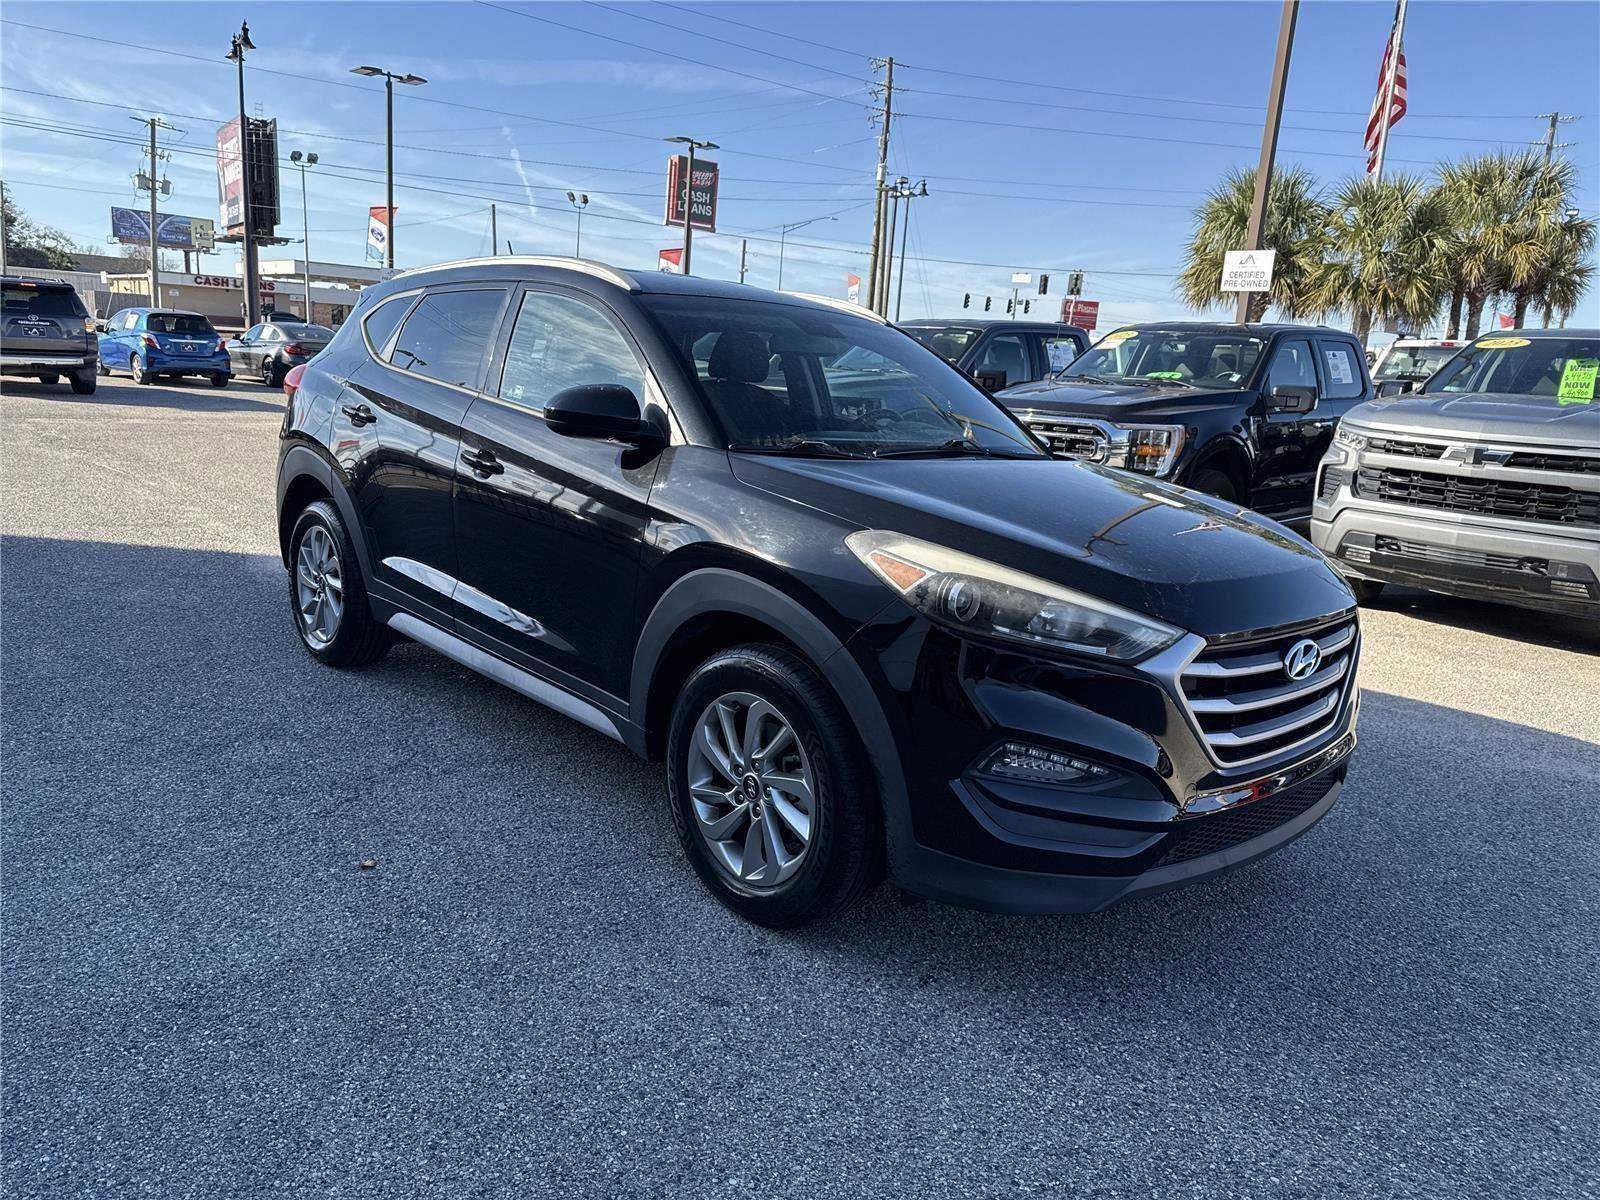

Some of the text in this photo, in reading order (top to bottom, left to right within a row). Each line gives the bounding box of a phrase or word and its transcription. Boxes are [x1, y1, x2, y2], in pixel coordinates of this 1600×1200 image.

[1229, 271, 1266, 279] CERTIFIED
[194, 275, 230, 287] CASH
[233, 278, 276, 291] LNS
[1223, 279, 1269, 288] PRE-OWNED
